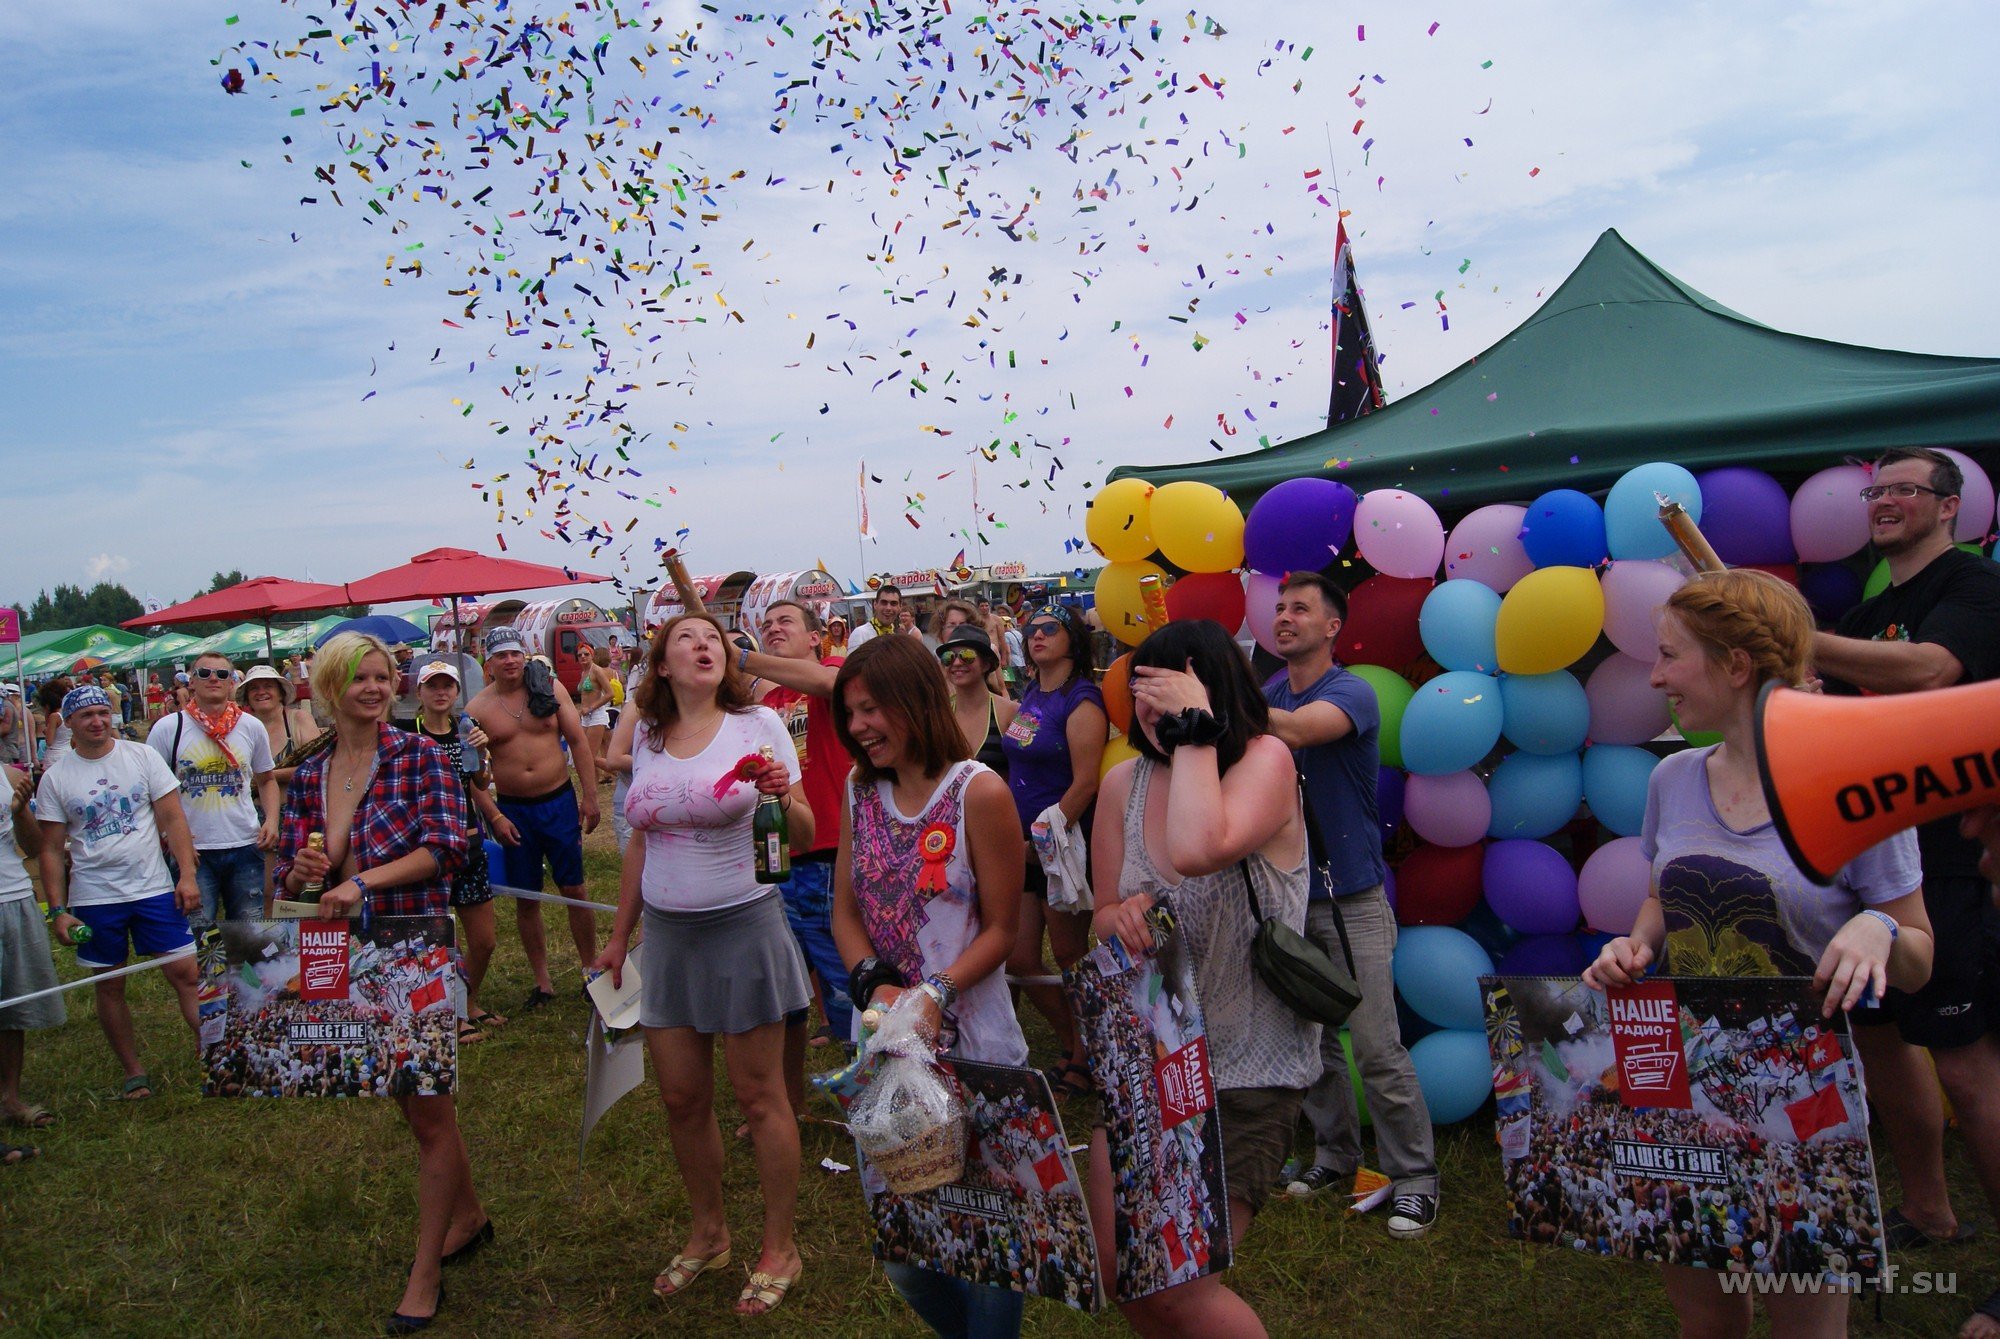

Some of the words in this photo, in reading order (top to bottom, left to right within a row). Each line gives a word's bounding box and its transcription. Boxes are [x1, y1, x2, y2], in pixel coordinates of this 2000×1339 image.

[1835, 748, 2000, 822] ОРАЛ
[302, 931, 347, 947] НАШЕ
[302, 948, 337, 956] РАДИО
[1611, 999, 1677, 1023] НАШЕ
[291, 1024, 364, 1038] НАШЕСТВИЕ
[1615, 1024, 1664, 1036] РАДИО
[1188, 1043, 1207, 1110] НАШЕ
[1128, 1060, 1151, 1164] НАШЕСТВИЕ
[1613, 1143, 1724, 1174] НАШЕСТВИЕ
